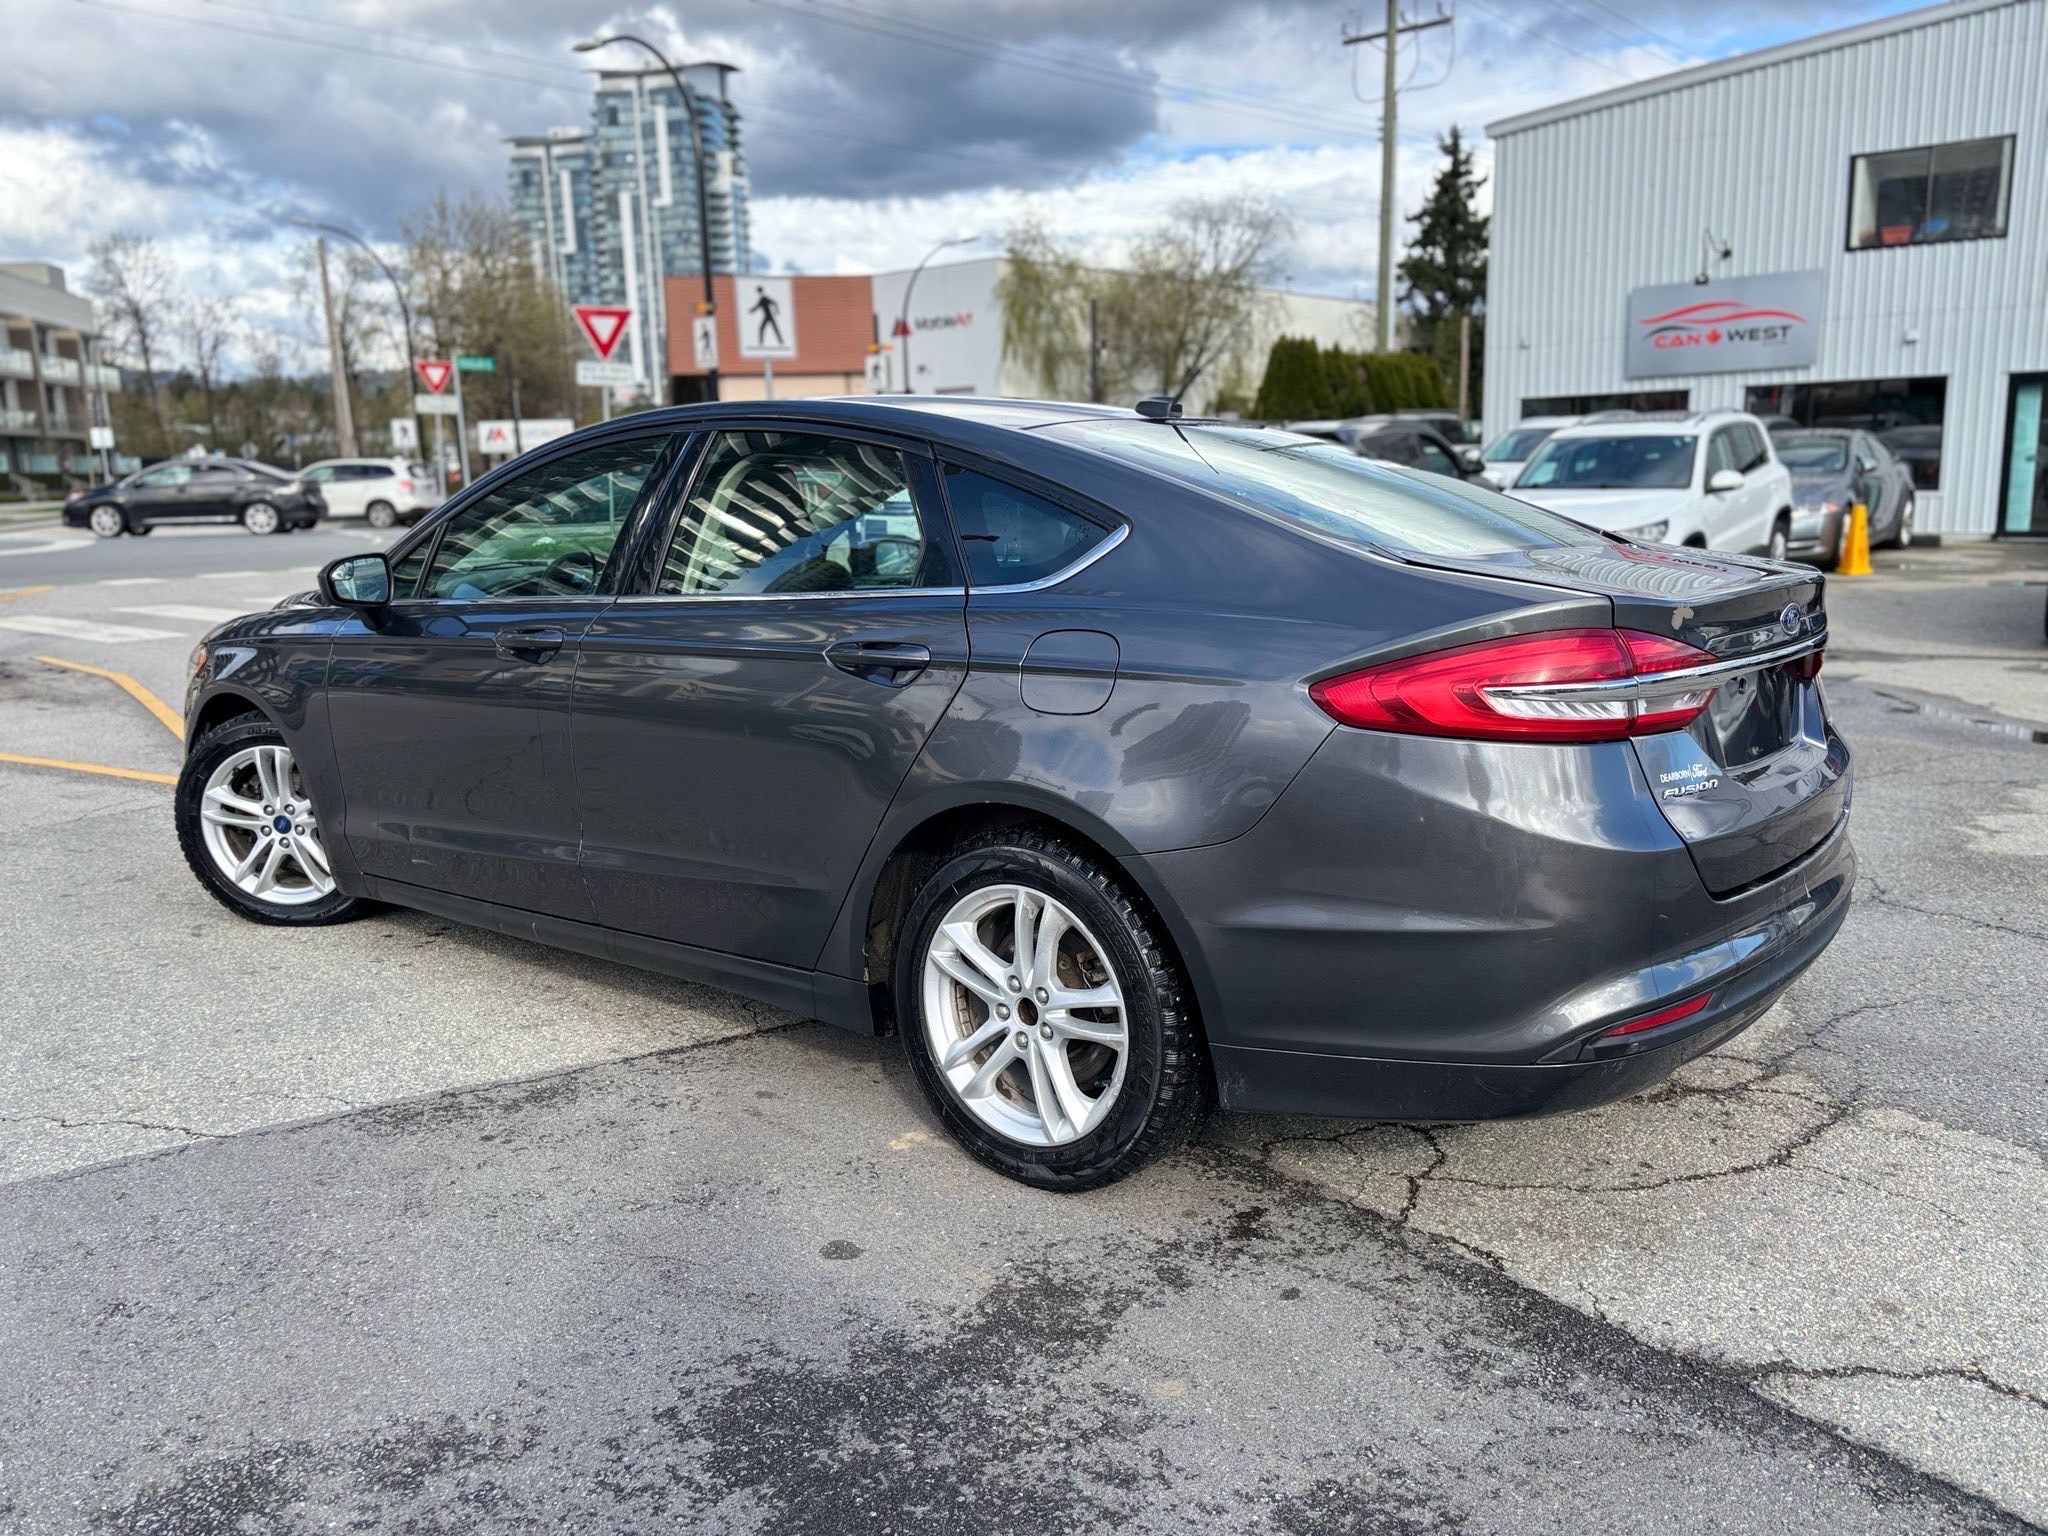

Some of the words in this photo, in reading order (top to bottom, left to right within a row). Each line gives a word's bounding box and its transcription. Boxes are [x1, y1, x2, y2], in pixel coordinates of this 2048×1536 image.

[1653, 334, 1701, 349] CAN
[1726, 325, 1791, 342] WEST
[1660, 769, 1691, 783] DEARBORN
[1692, 763, 1708, 779] Ford
[1662, 778, 1719, 800] FUSION
